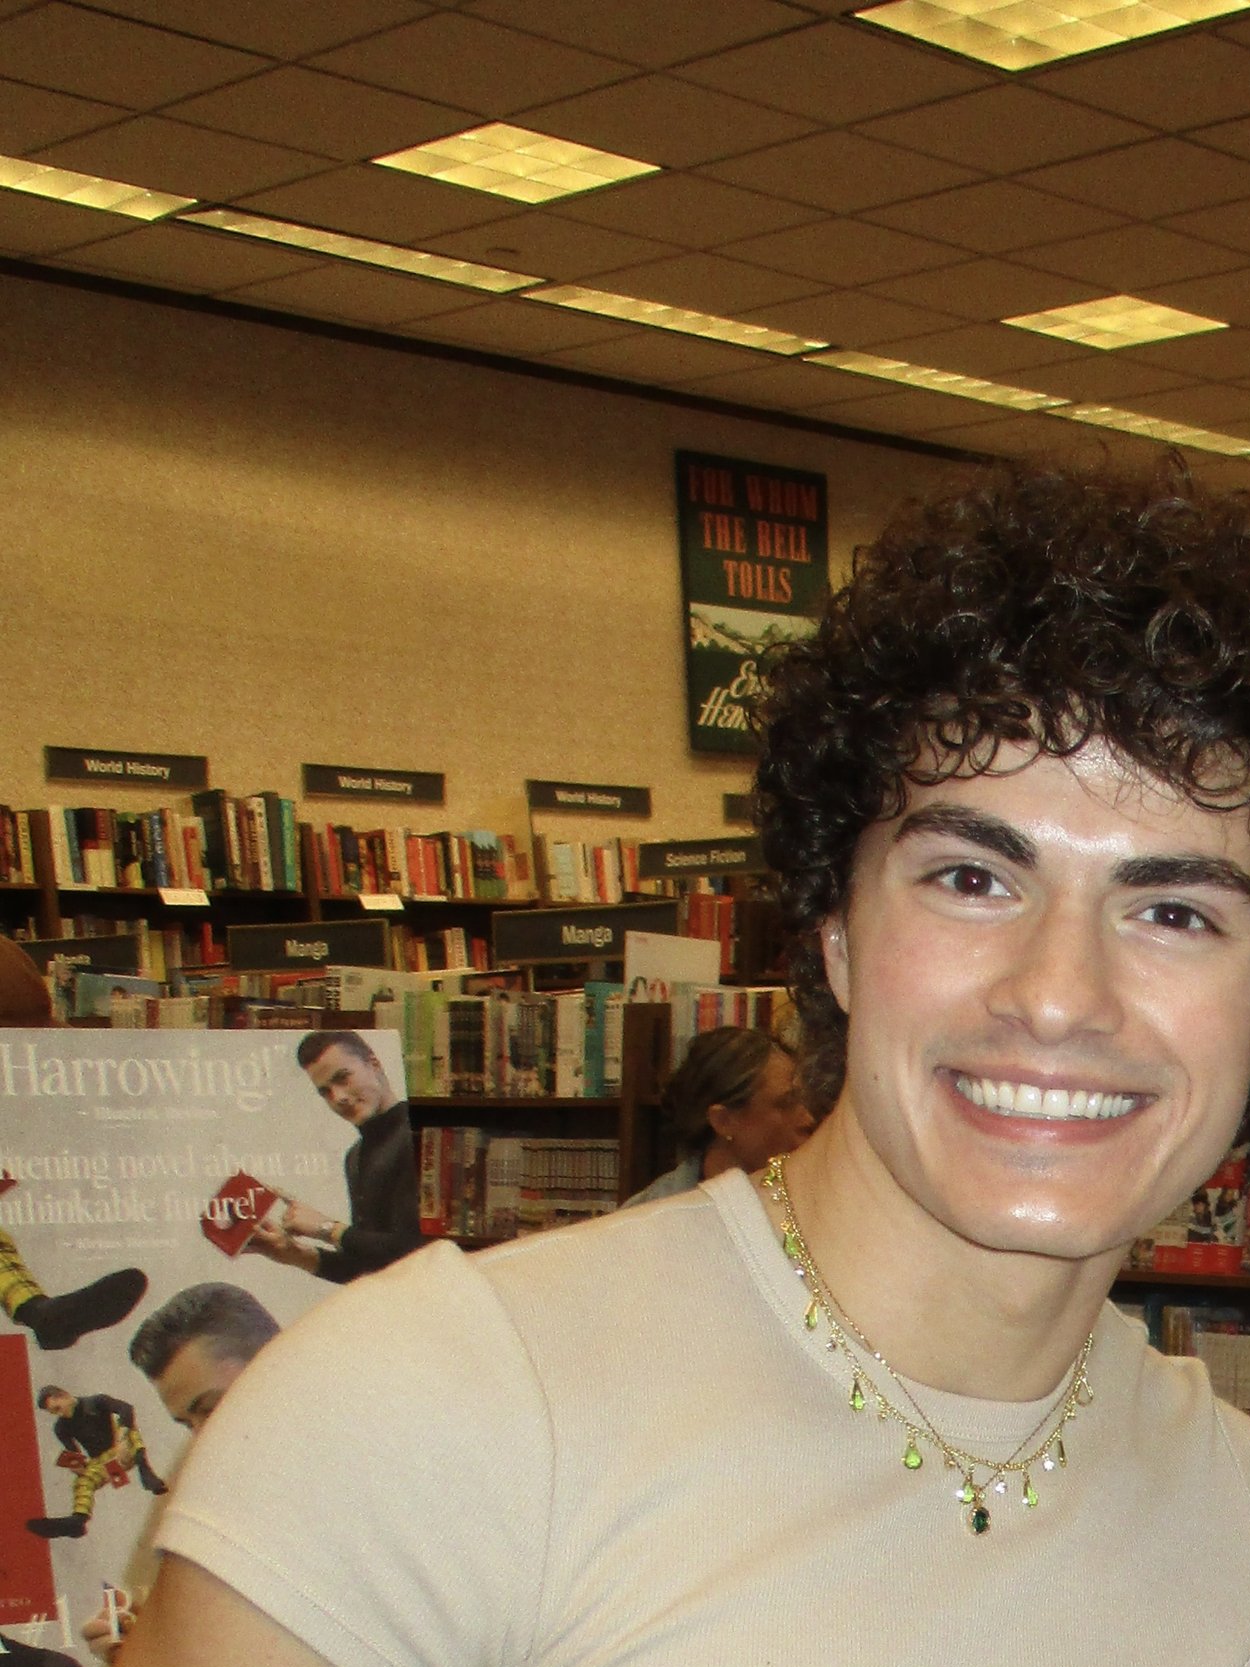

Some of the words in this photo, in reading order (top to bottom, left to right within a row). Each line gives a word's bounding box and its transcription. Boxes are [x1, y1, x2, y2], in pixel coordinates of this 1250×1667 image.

[689, 464, 735, 507] FOR
[746, 473, 817, 522] WHOM
[699, 511, 746, 554] THE
[757, 519, 811, 562] BELL
[723, 558, 792, 603] TOLLS
[85, 758, 122, 775] World
[126, 761, 171, 781] History
[338, 774, 372, 790] World
[374, 777, 414, 795] History
[555, 789, 586, 803] World
[587, 791, 622, 808] History
[665, 851, 708, 868] Science
[710, 849, 747, 864] Fiction
[561, 925, 613, 947] Manga
[285, 938, 329, 960] Manga
[119, 1146, 195, 1178] novel
[294, 1152, 329, 1177] an
